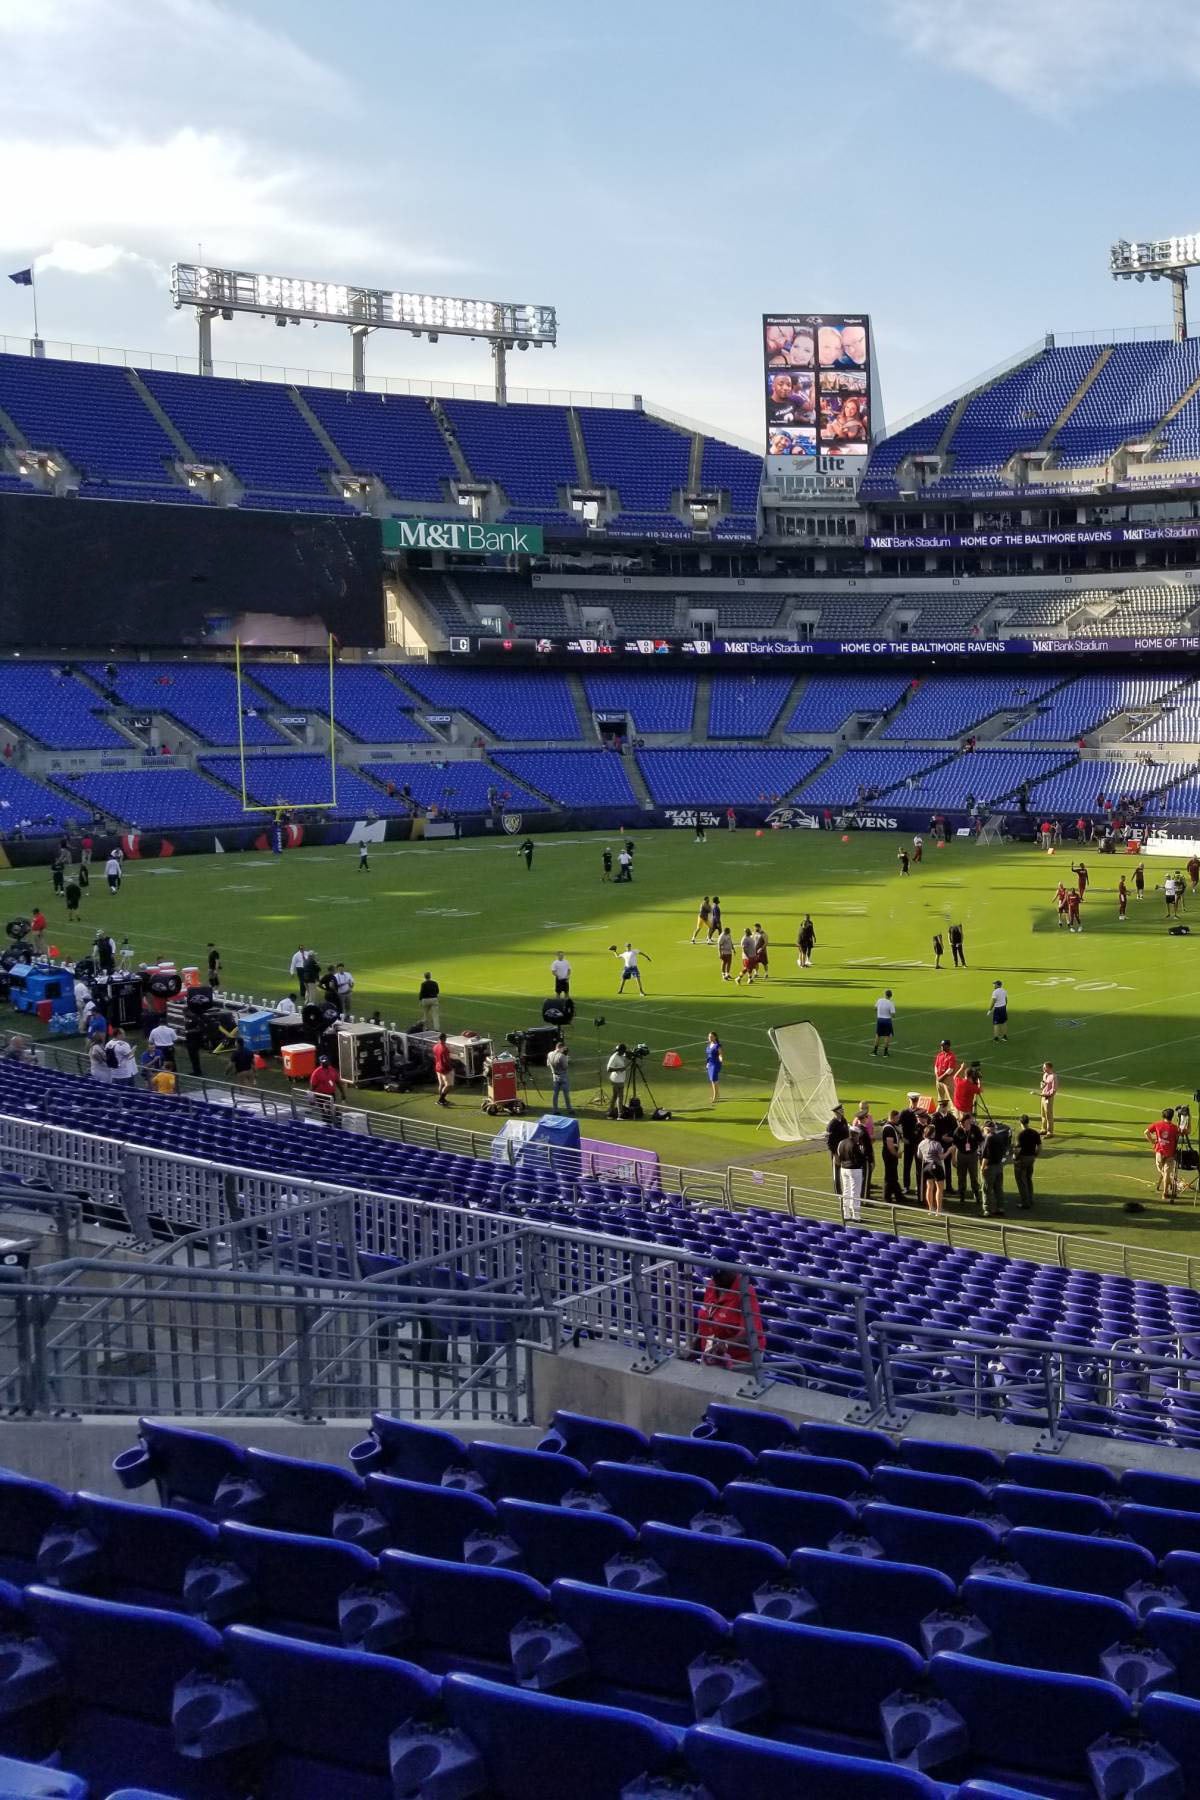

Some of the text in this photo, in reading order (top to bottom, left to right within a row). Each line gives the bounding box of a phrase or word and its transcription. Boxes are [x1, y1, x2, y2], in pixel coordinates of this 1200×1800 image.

[815, 456, 845, 475] Lite
[398, 521, 529, 551] M&T Bank
[870, 531, 1112, 548] M&T Bank Stadium HOME OF THE BALTIMORE RAVENS
[1123, 529, 1143, 541] M&T
[1144, 527, 1164, 540] Bank
[1165, 526, 1199, 539] Stadium
[724, 641, 1005, 653] M&T Bank Stadium HOME OF THE BALTIMORE RAVENS
[1032, 641, 1053, 652] M&T
[1053, 640, 1074, 651] Bank
[1074, 640, 1109, 651] Stadium
[1134, 638, 1162, 649] HOME
[1164, 637, 1178, 648] OF
[1180, 637, 1199, 648] THE
[665, 810, 692, 818] PLAY
[283, 1055, 291, 1069] G
